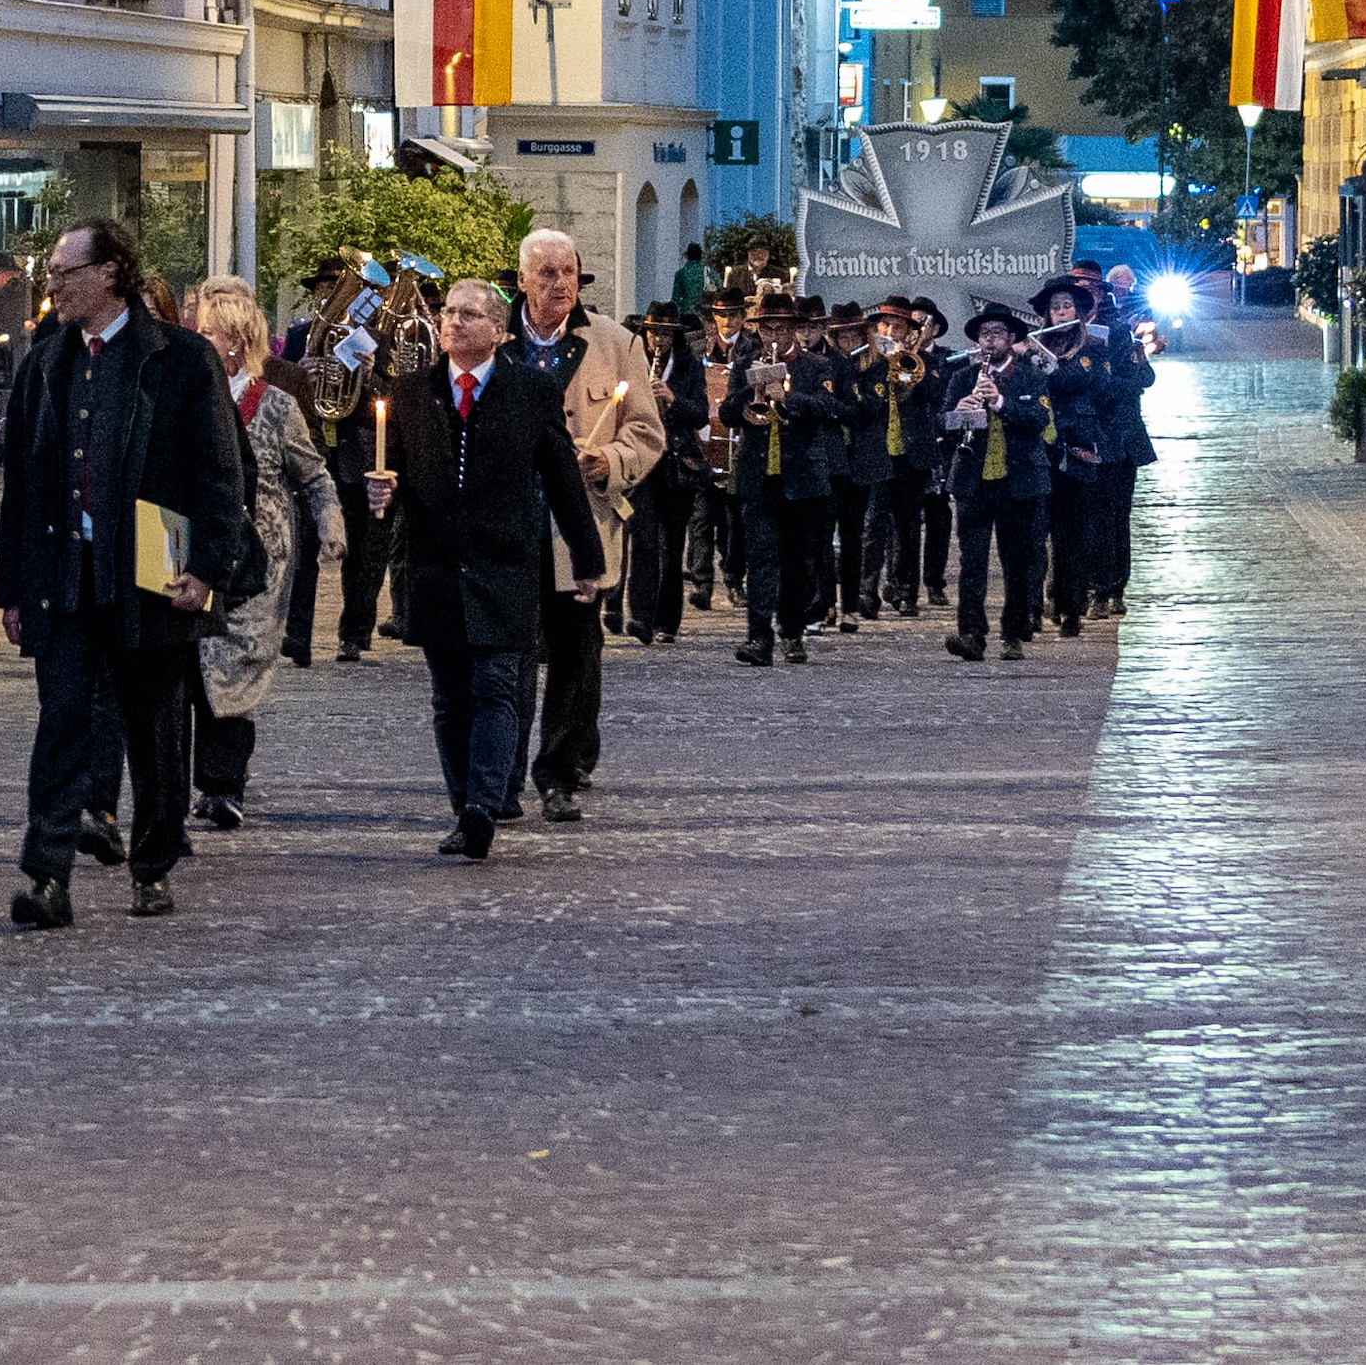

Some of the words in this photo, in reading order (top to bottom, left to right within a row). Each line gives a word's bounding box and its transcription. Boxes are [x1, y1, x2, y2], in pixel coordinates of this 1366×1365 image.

[530, 141, 583, 154] Burggasse
[899, 139, 969, 162] 1918
[814, 248, 903, 278] kärntner
[906, 243, 1060, 280] freiheitskampf
